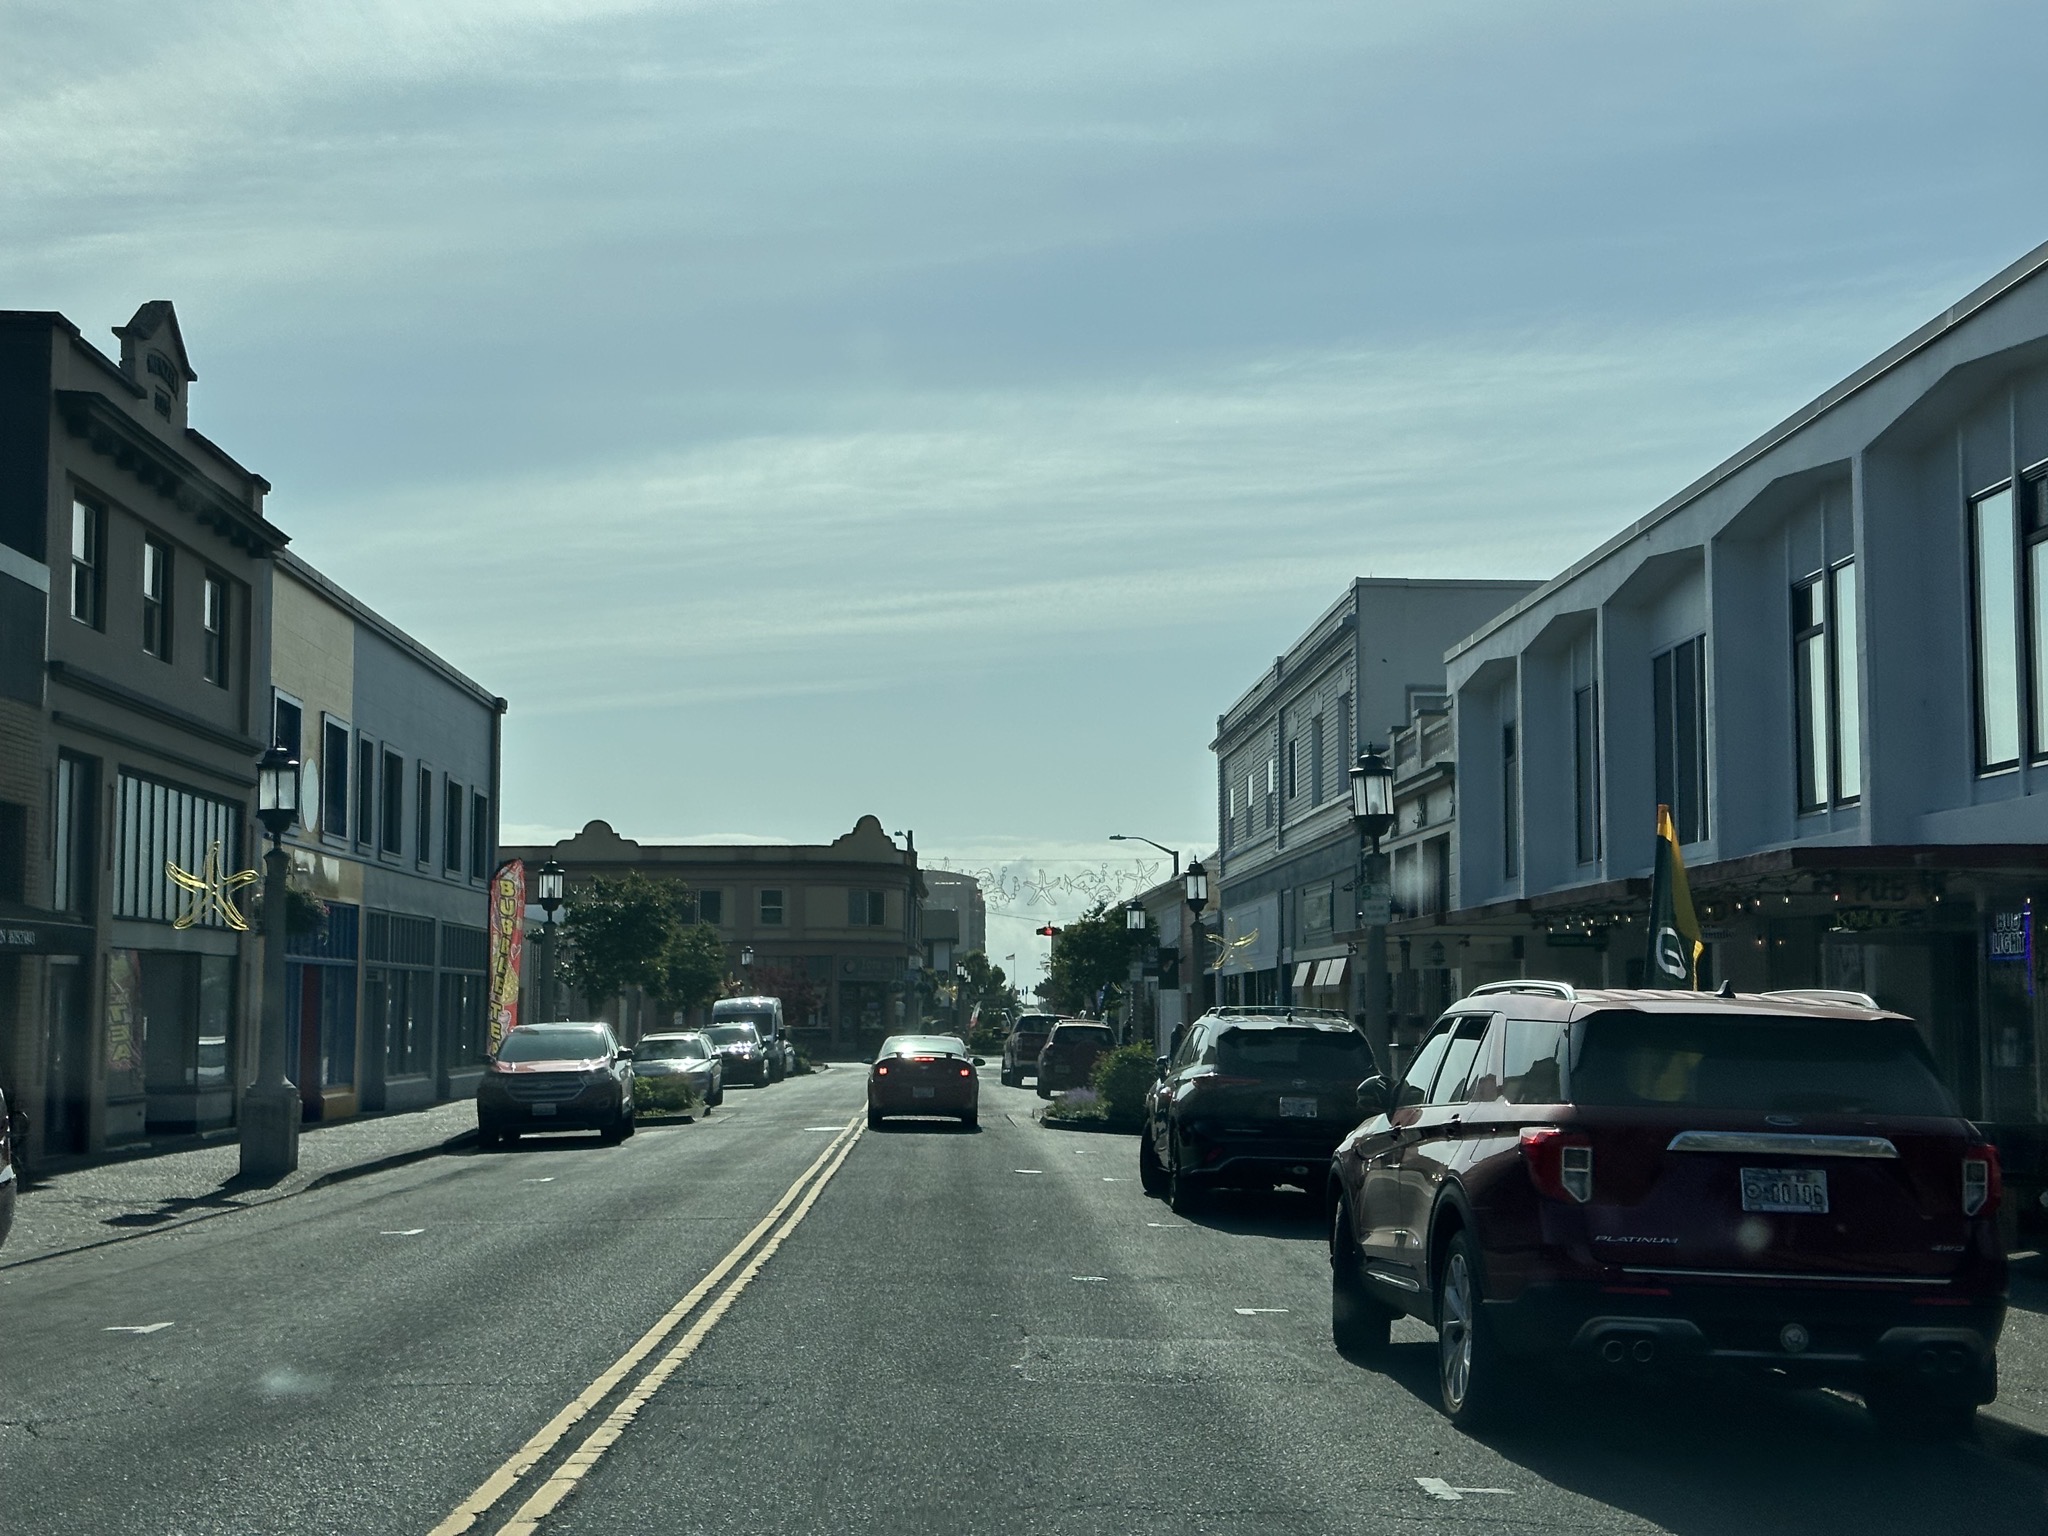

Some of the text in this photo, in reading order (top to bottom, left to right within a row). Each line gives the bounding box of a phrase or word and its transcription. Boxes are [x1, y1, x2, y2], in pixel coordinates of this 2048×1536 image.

[1996, 912, 2021, 932] BUD
[1992, 931, 2026, 954] LIGHT
[1594, 1234, 1680, 1244] PLATINUM
